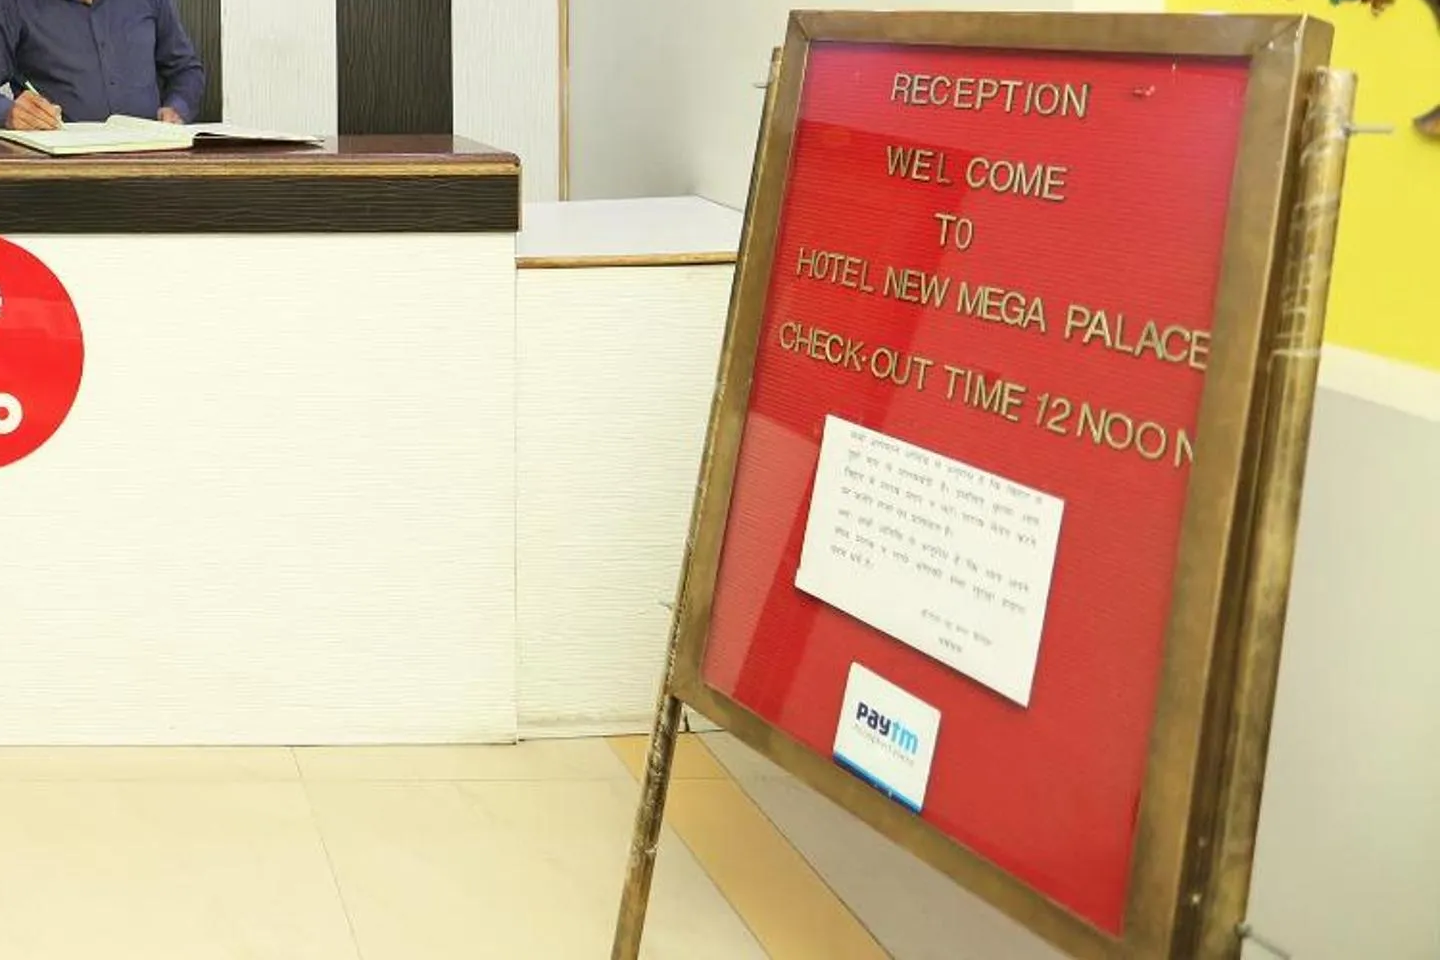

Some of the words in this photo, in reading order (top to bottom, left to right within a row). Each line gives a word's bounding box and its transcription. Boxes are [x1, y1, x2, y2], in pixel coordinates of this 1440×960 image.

[890, 72, 1089, 119] RECEPTION
[933, 212, 975, 250] TO
[796, 246, 875, 293] HOTEL
[882, 266, 951, 309] NEW
[956, 281, 1047, 334] MEGA
[1063, 303, 1211, 371] PALACE
[943, 364, 1027, 423] TIME
[1036, 392, 1074, 435] 12
